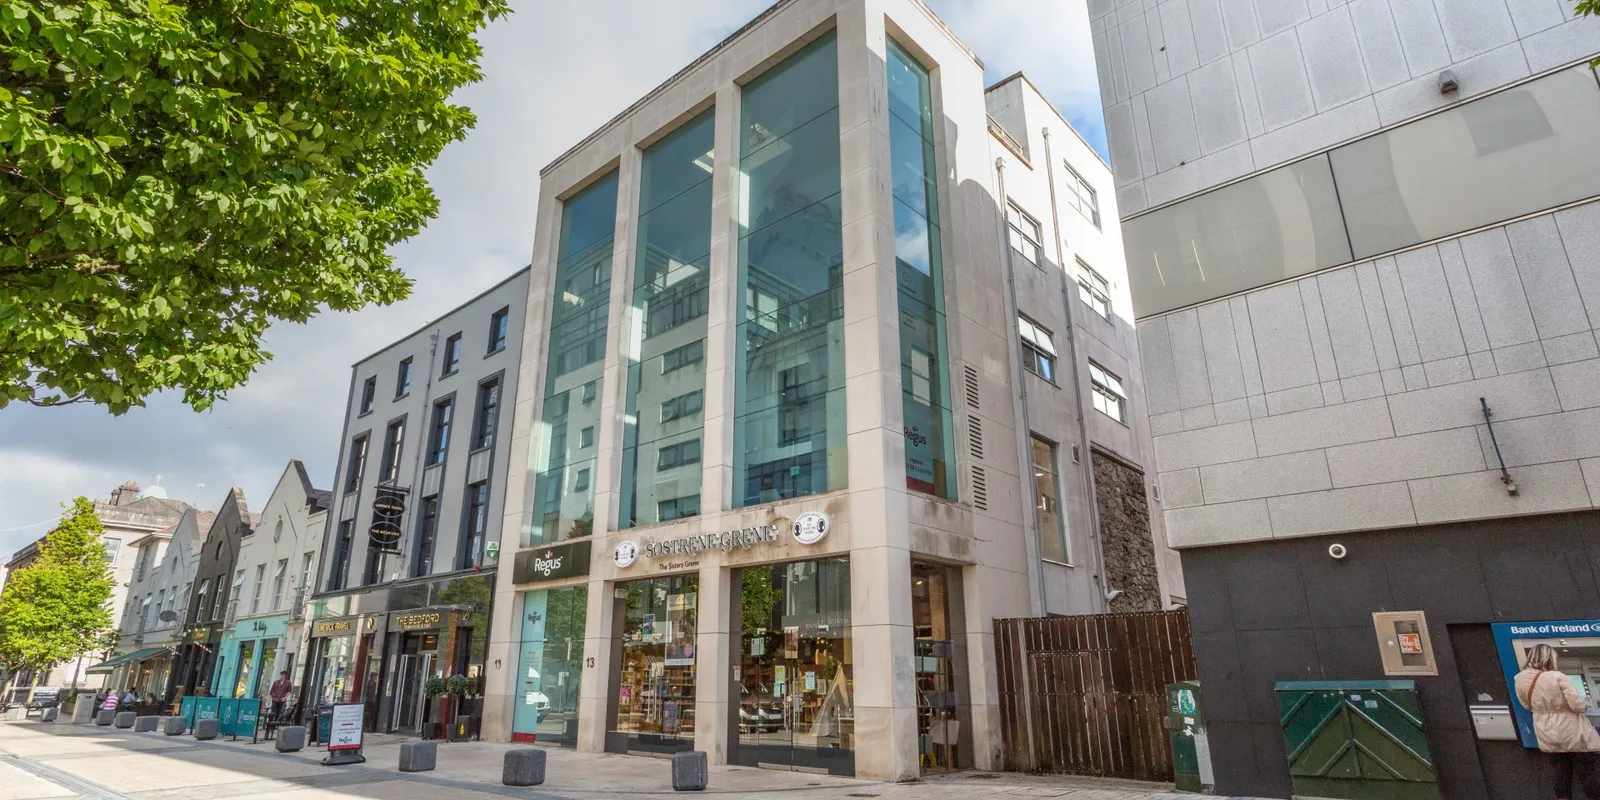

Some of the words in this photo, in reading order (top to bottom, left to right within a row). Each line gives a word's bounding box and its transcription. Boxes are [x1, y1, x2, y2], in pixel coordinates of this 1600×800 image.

[904, 427, 927, 447] Regus
[534, 557, 562, 577] Regus
[659, 563, 668, 571] The
[668, 561, 684, 570] Sisters
[684, 560, 699, 568] Grene
[396, 616, 408, 626] THE
[408, 613, 440, 625] BEDFORD
[528, 613, 542, 625] Regus
[1510, 625, 1538, 634] Bank
[1537, 624, 1550, 633] of
[1551, 624, 1590, 633] Ireland
[494, 659, 502, 670] 13
[586, 657, 595, 668] 13
